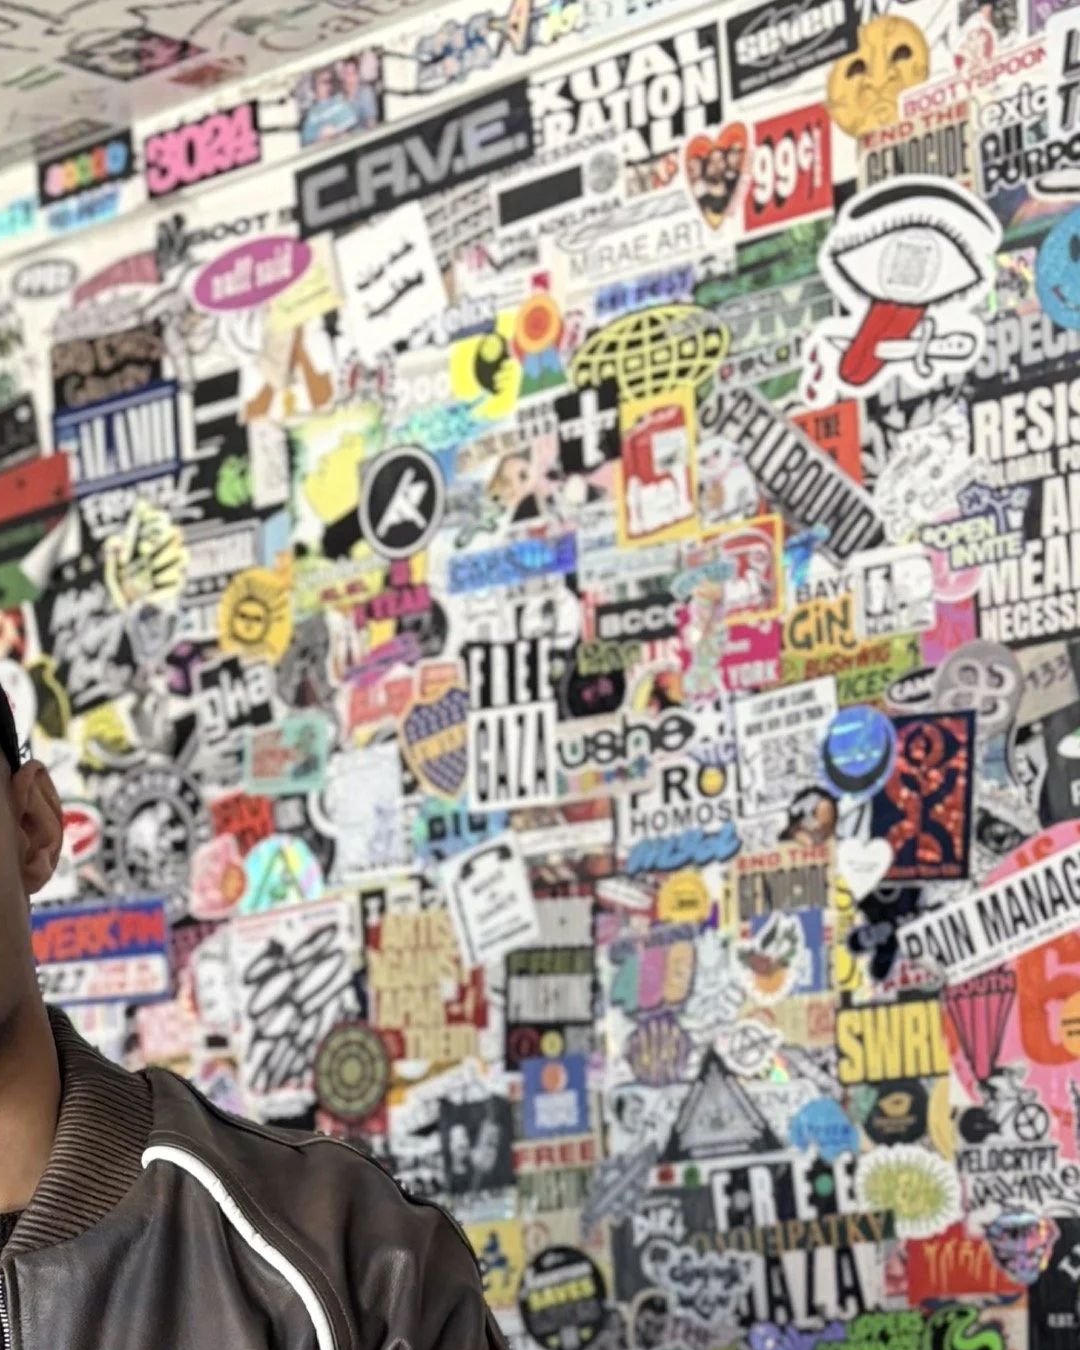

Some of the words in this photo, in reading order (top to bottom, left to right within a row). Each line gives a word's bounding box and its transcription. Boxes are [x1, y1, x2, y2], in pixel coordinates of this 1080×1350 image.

[146, 104, 258, 192] 3024
[980, 590, 1080, 643] NECESS
[631, 799, 733, 836] HOMOS
